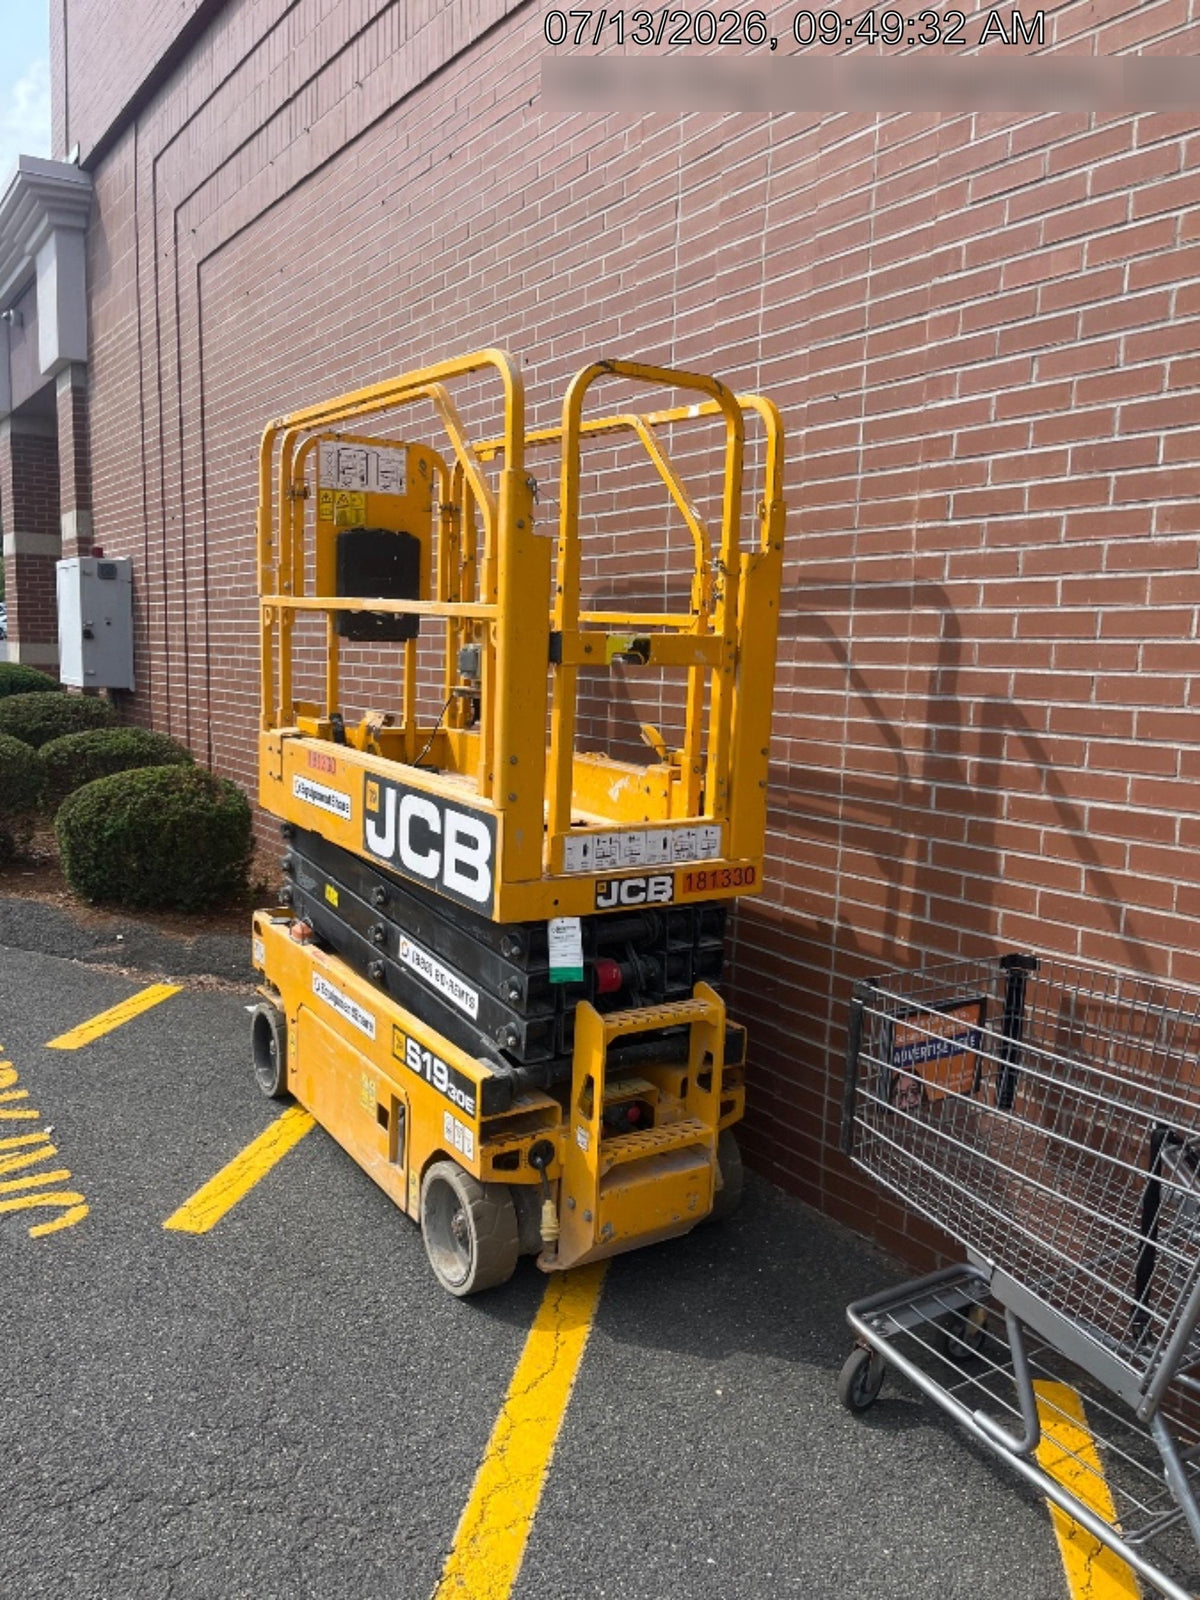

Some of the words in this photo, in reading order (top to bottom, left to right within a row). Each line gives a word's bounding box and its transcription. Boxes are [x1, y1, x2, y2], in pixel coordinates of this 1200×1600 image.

[365, 787, 492, 903] JCB
[596, 875, 674, 908] JCB
[685, 865, 756, 892] 181330
